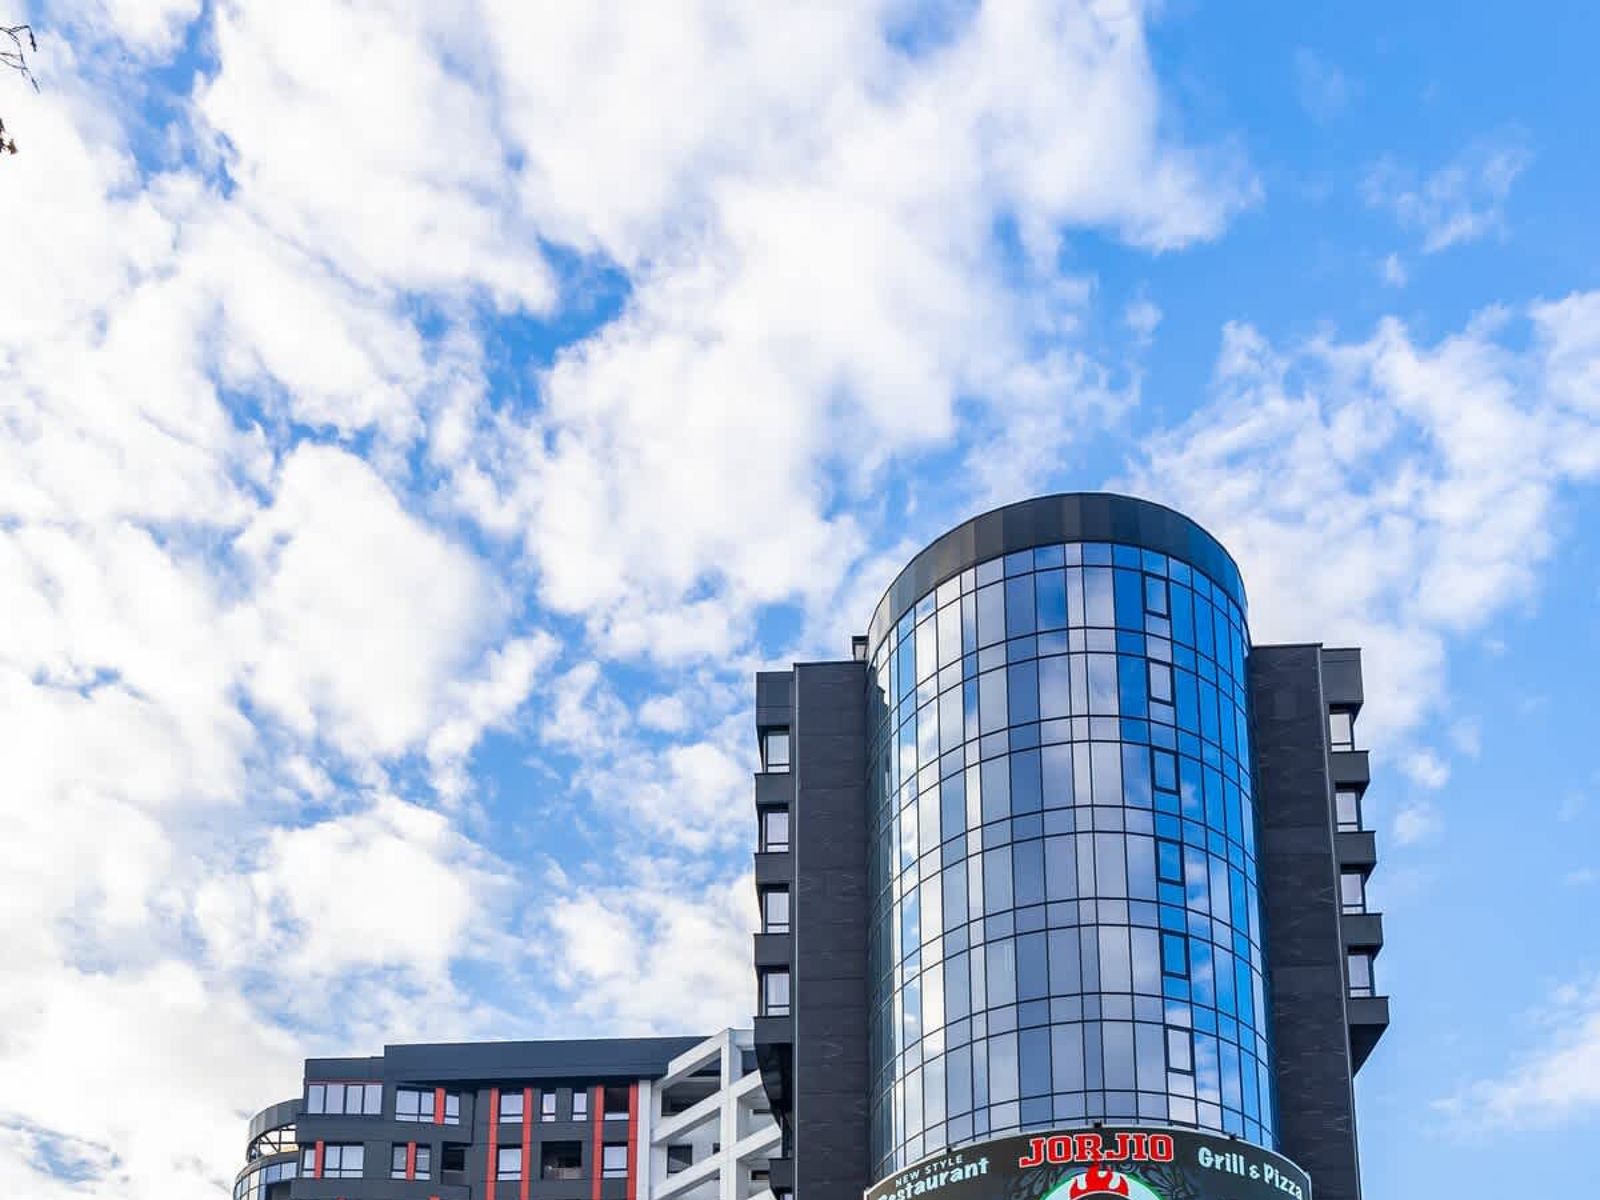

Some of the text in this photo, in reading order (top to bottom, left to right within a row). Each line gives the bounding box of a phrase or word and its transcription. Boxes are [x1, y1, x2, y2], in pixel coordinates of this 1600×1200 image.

[1019, 1132, 1174, 1168] JORJIO
[895, 1154, 963, 1187] NEW STYLE
[1198, 1147, 1303, 1200] Grill & Pizza
